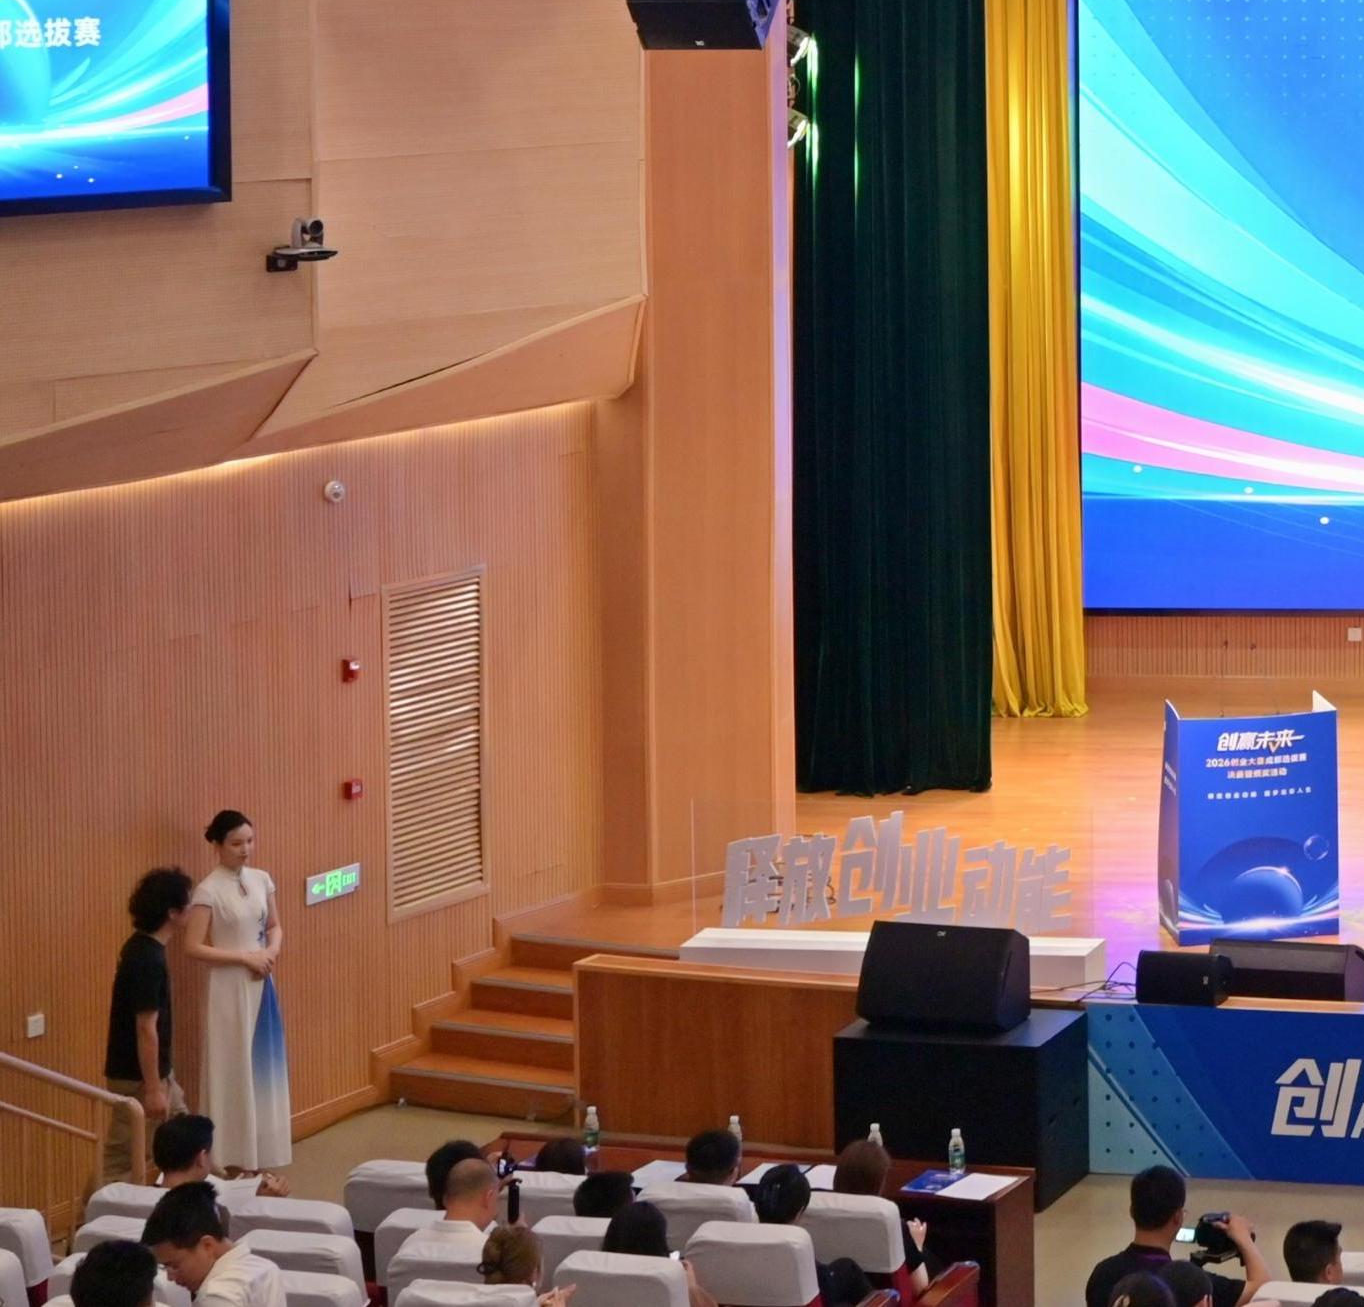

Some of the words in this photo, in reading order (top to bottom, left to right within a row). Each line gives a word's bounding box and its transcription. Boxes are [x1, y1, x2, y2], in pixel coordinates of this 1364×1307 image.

[1217, 730, 1304, 751] 创赢未来
[343, 872, 357, 886] EXIT
[722, 811, 1073, 933] 释放创业动能
